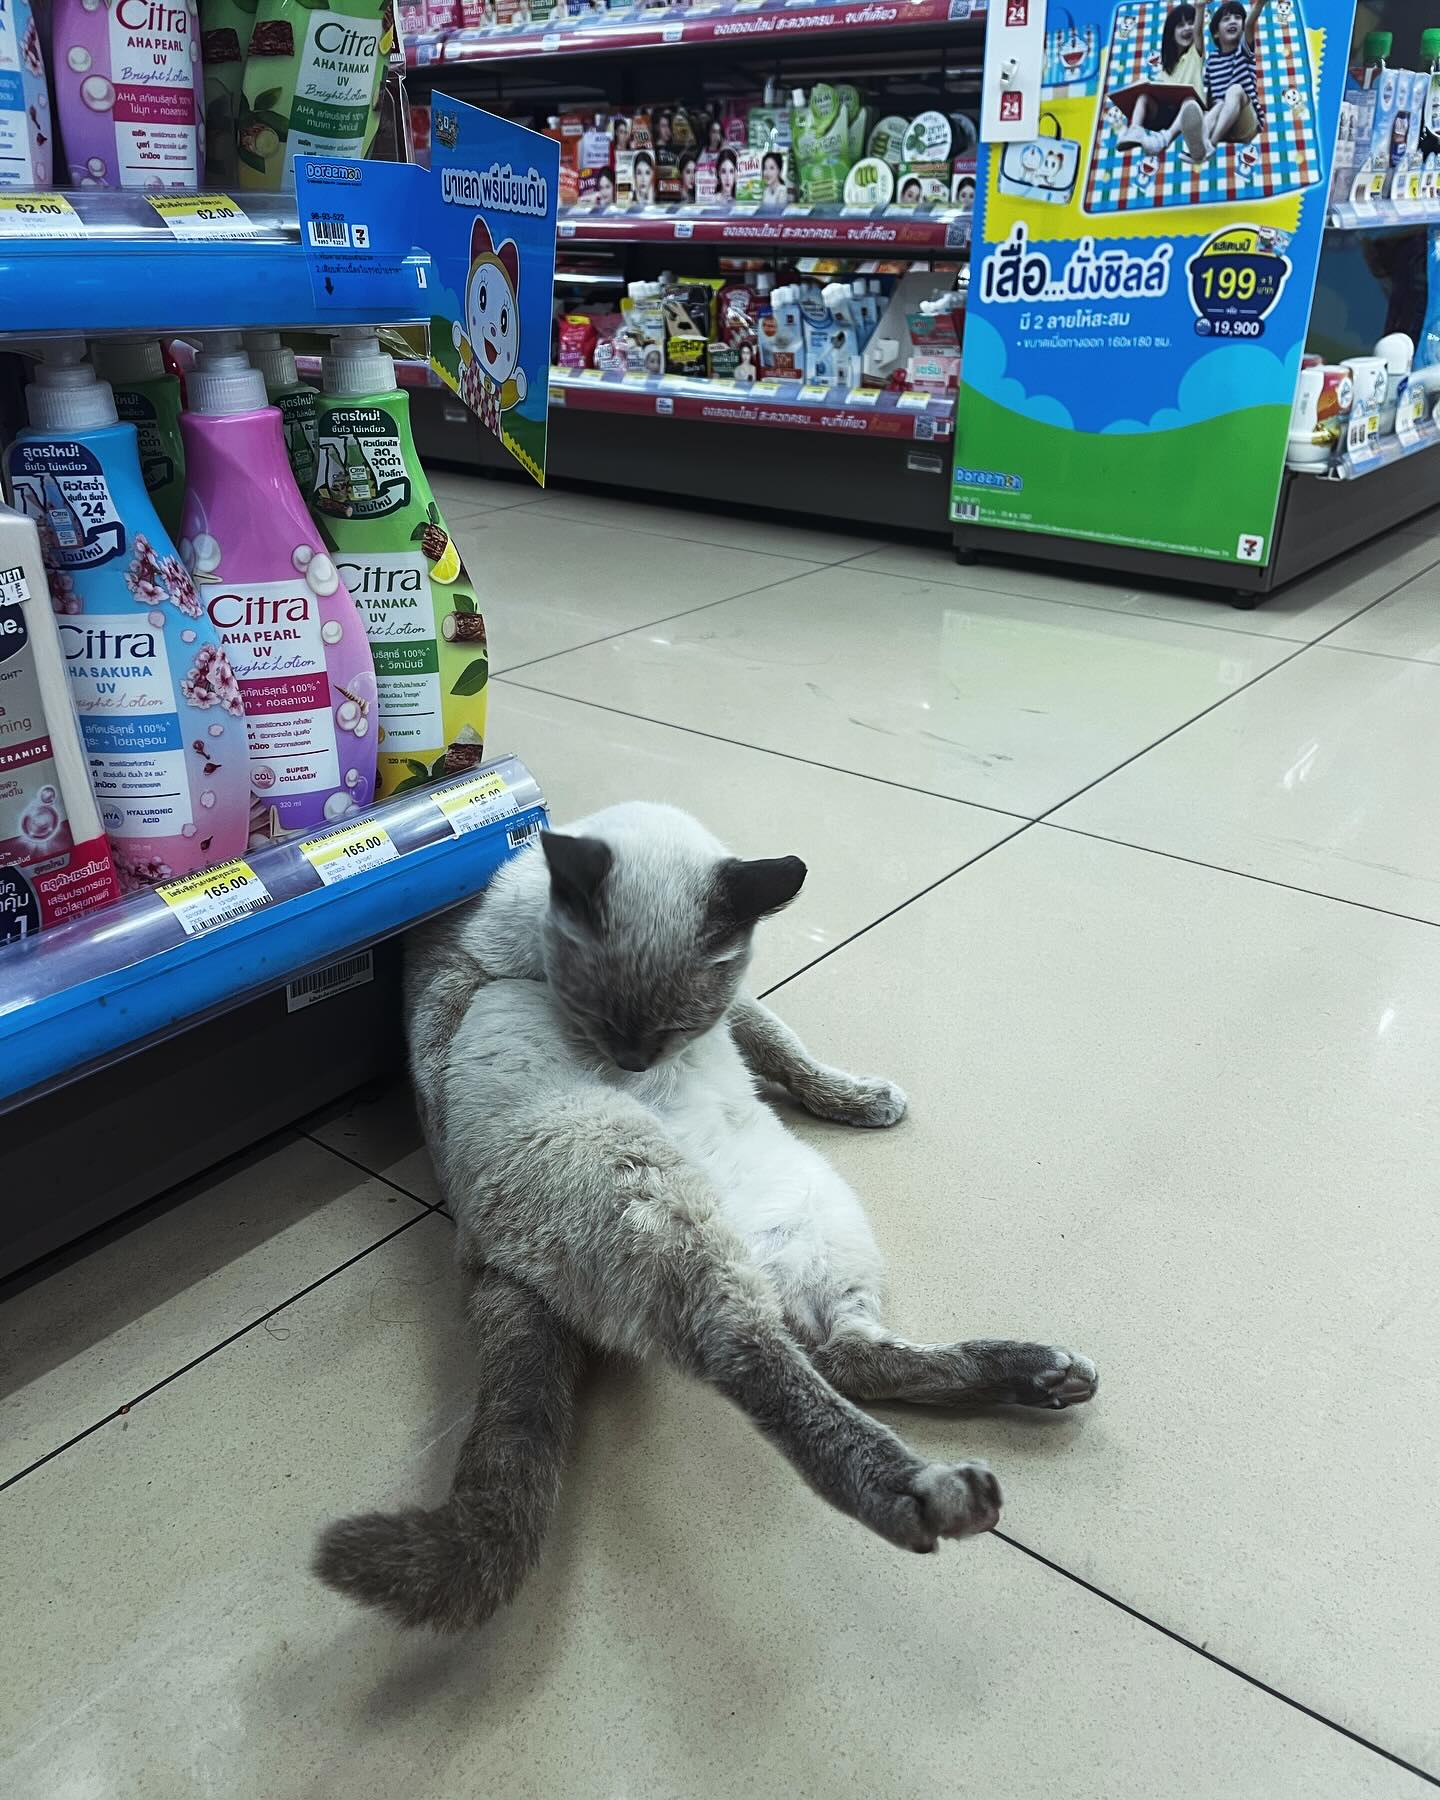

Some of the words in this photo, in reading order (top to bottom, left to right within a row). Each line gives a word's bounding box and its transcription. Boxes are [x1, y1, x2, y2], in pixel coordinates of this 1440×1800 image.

[116, 0, 187, 34] Citra
[127, 36, 153, 49] AHA
[154, 38, 184, 52] PEARL
[314, 22, 377, 57] Citra
[153, 53, 167, 65] UV
[312, 57, 336, 71] AHA
[337, 61, 370, 74] TANAKA
[121, 66, 165, 84] Bright
[165, 67, 190, 82] Lotion
[337, 76, 350, 87] UV
[117, 92, 137, 102] AHA
[304, 83, 345, 102] Bright
[296, 104, 315, 116] AHA
[1002, 101, 1021, 117] 24
[305, 163, 363, 182] Doraemon
[442, 171, 480, 204] มาแลก
[481, 167, 546, 212] พรีเมียมกัน
[15, 202, 62, 216] 62.00
[196, 207, 235, 221] 62.00
[1201, 266, 1258, 301] 199
[1019, 312, 1032, 331] มี
[1033, 315, 1044, 331] 2
[1046, 308, 1131, 330] ลายให้สะสม
[1212, 319, 1261, 338] 19,900
[331, 410, 381, 425] สูตรใหม่!
[331, 425, 351, 433] ซึมไว
[352, 424, 386, 433] ไม่เหนียว
[23, 443, 81, 462] สูตรใหม่!
[373, 447, 391, 457] ลด
[24, 462, 46, 472] ซึมไว
[47, 461, 88, 472] ไม่เหนียว
[63, 476, 105, 491] ผิวใสฉ่ำ
[955, 466, 1023, 491] Doraemon
[80, 502, 106, 517] 24
[354, 494, 393, 513] โฉมใหม่
[62, 543, 104, 562] โฉมใหม่
[336, 562, 422, 593] Citra
[364, 597, 418, 609] TANAKA
[207, 594, 309, 629] Citra
[369, 612, 387, 623] UV
[384, 621, 426, 636] Lotion
[58, 624, 157, 660] Citra
[221, 632, 252, 645] AHA
[254, 628, 302, 642] PEARL
[252, 646, 272, 658] UV
[69, 666, 88, 678] HA
[90, 665, 153, 678] SAKURA
[231, 661, 271, 676] right
[271, 655, 316, 671] Lotion
[95, 682, 116, 694] UV
[116, 693, 163, 708] Lotion
[265, 694, 315, 708] คอลลาเจน
[0, 717, 32, 735] ning
[0, 744, 48, 765] ERAMIDE
[254, 773, 272, 781] COL
[285, 766, 310, 774] SUPER
[126, 807, 173, 816] HYALURONIC
[279, 801, 292, 809] 320
[103, 812, 119, 820] HYA
[342, 835, 381, 859] 165.00
[203, 875, 249, 900] 165.00
